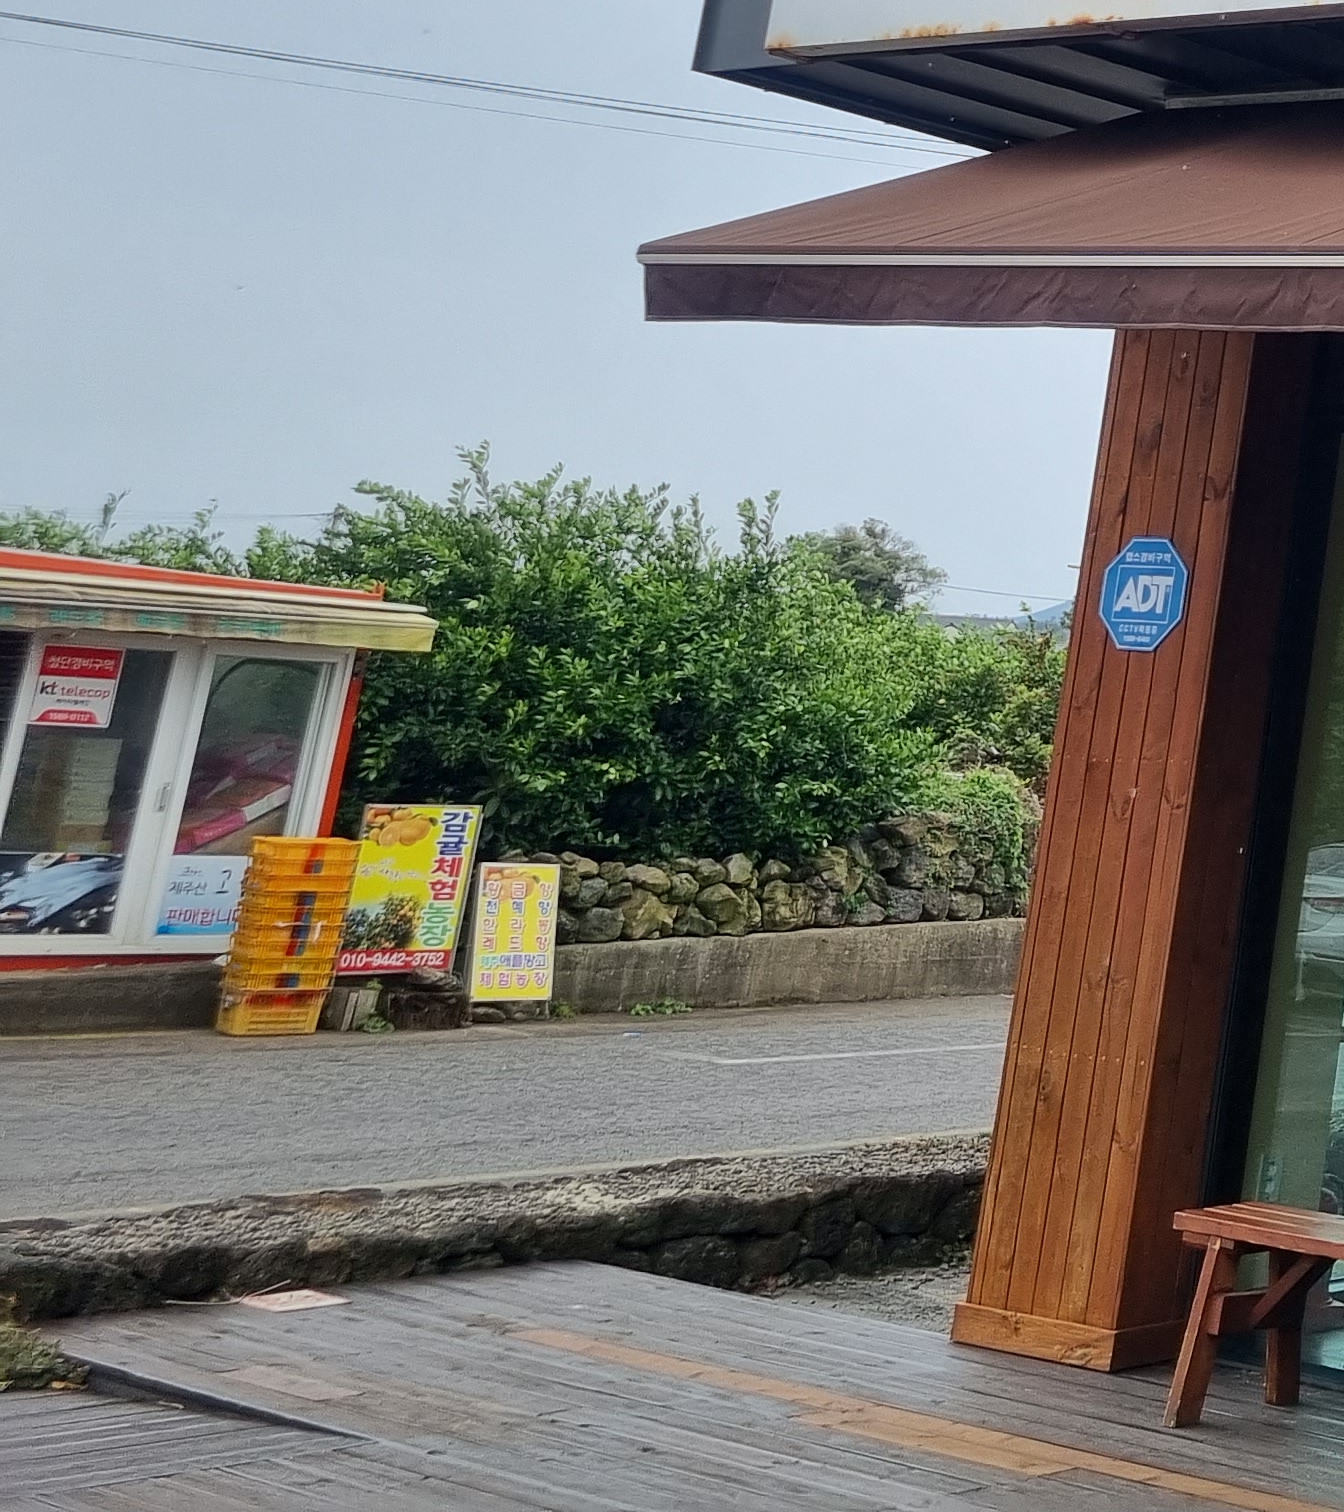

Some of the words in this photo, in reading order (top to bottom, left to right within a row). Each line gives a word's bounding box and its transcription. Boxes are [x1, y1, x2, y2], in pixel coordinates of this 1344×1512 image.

[1113, 574, 1174, 614] ADT
[61, 686, 110, 701] telecop
[340, 951, 445, 968] 010-9442-3752
